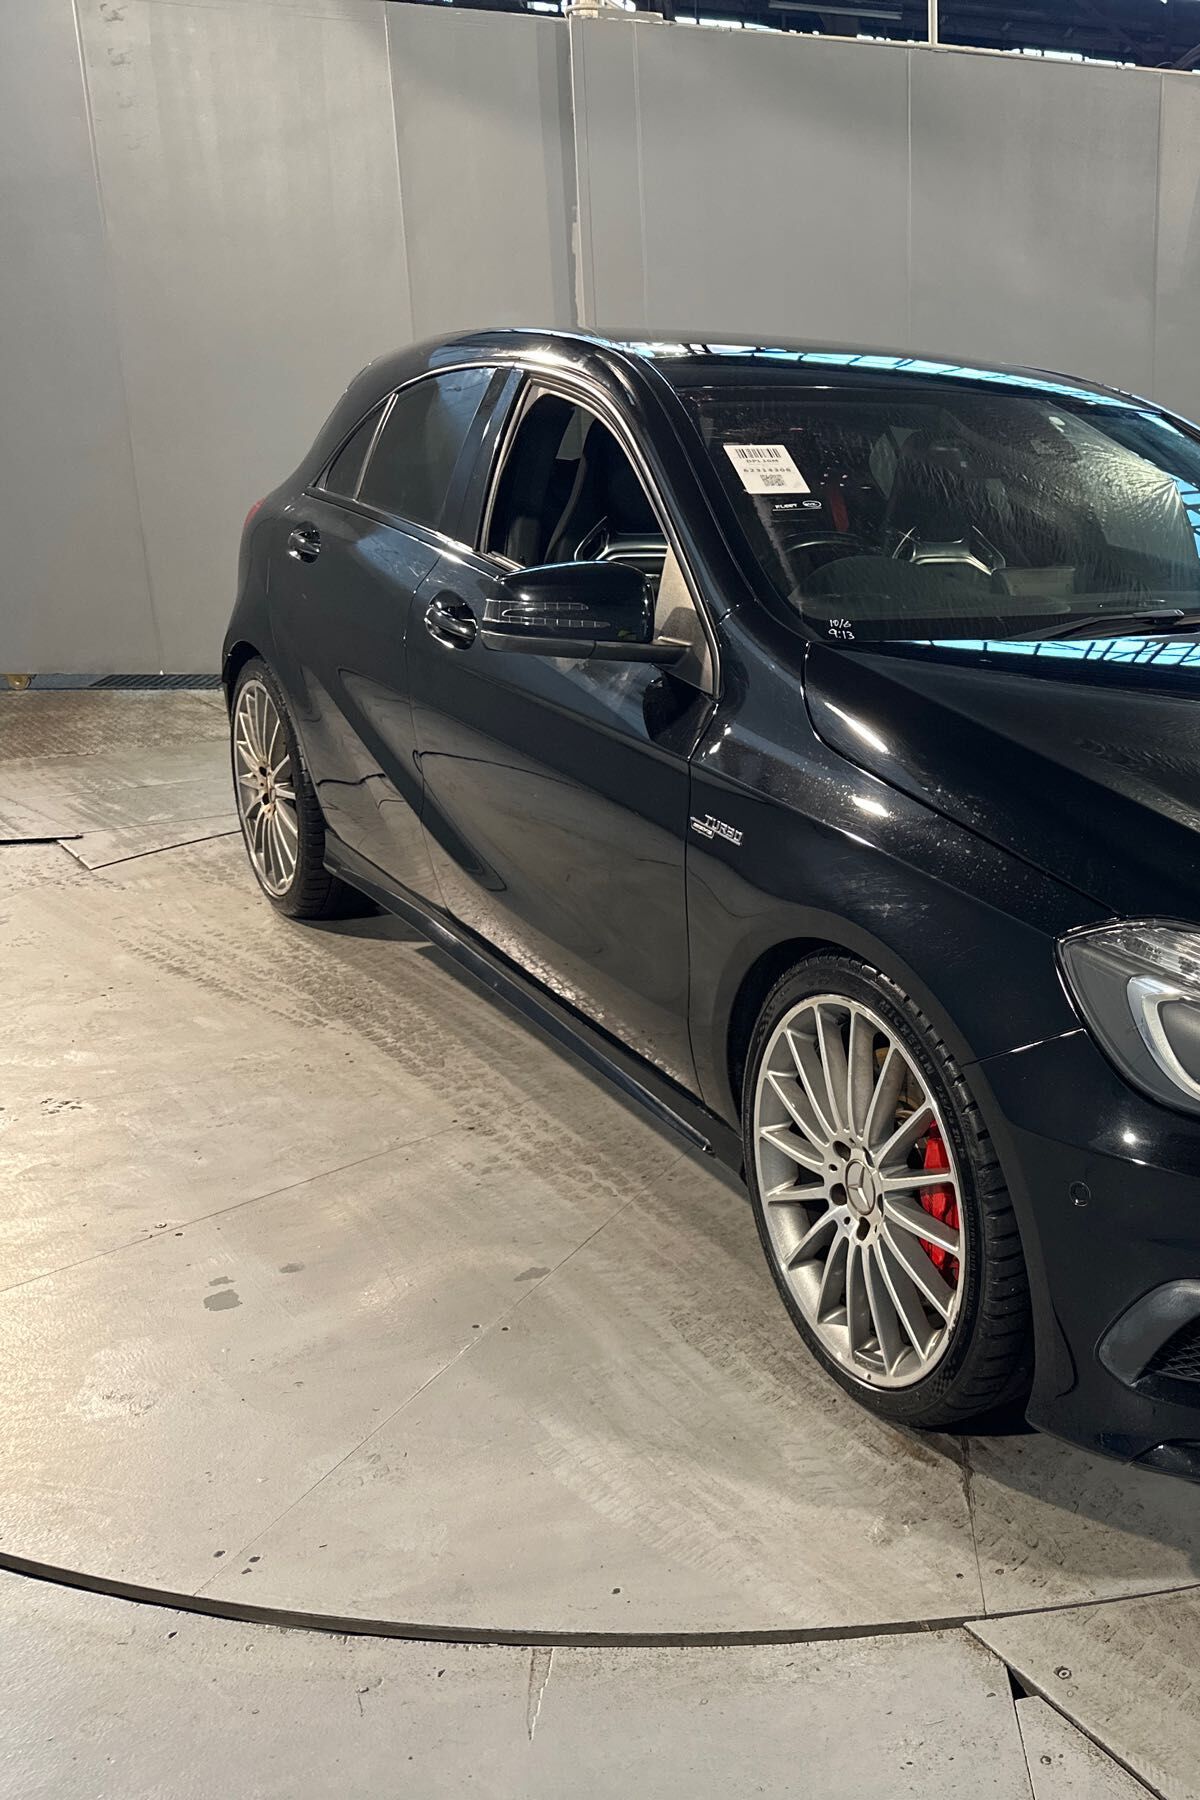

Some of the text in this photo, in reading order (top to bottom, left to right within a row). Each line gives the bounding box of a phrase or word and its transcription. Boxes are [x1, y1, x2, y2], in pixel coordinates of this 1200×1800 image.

[828, 628, 855, 640] 9:13
[704, 813, 743, 842] TURBO
[879, 1000, 935, 1075] MICHELIN
